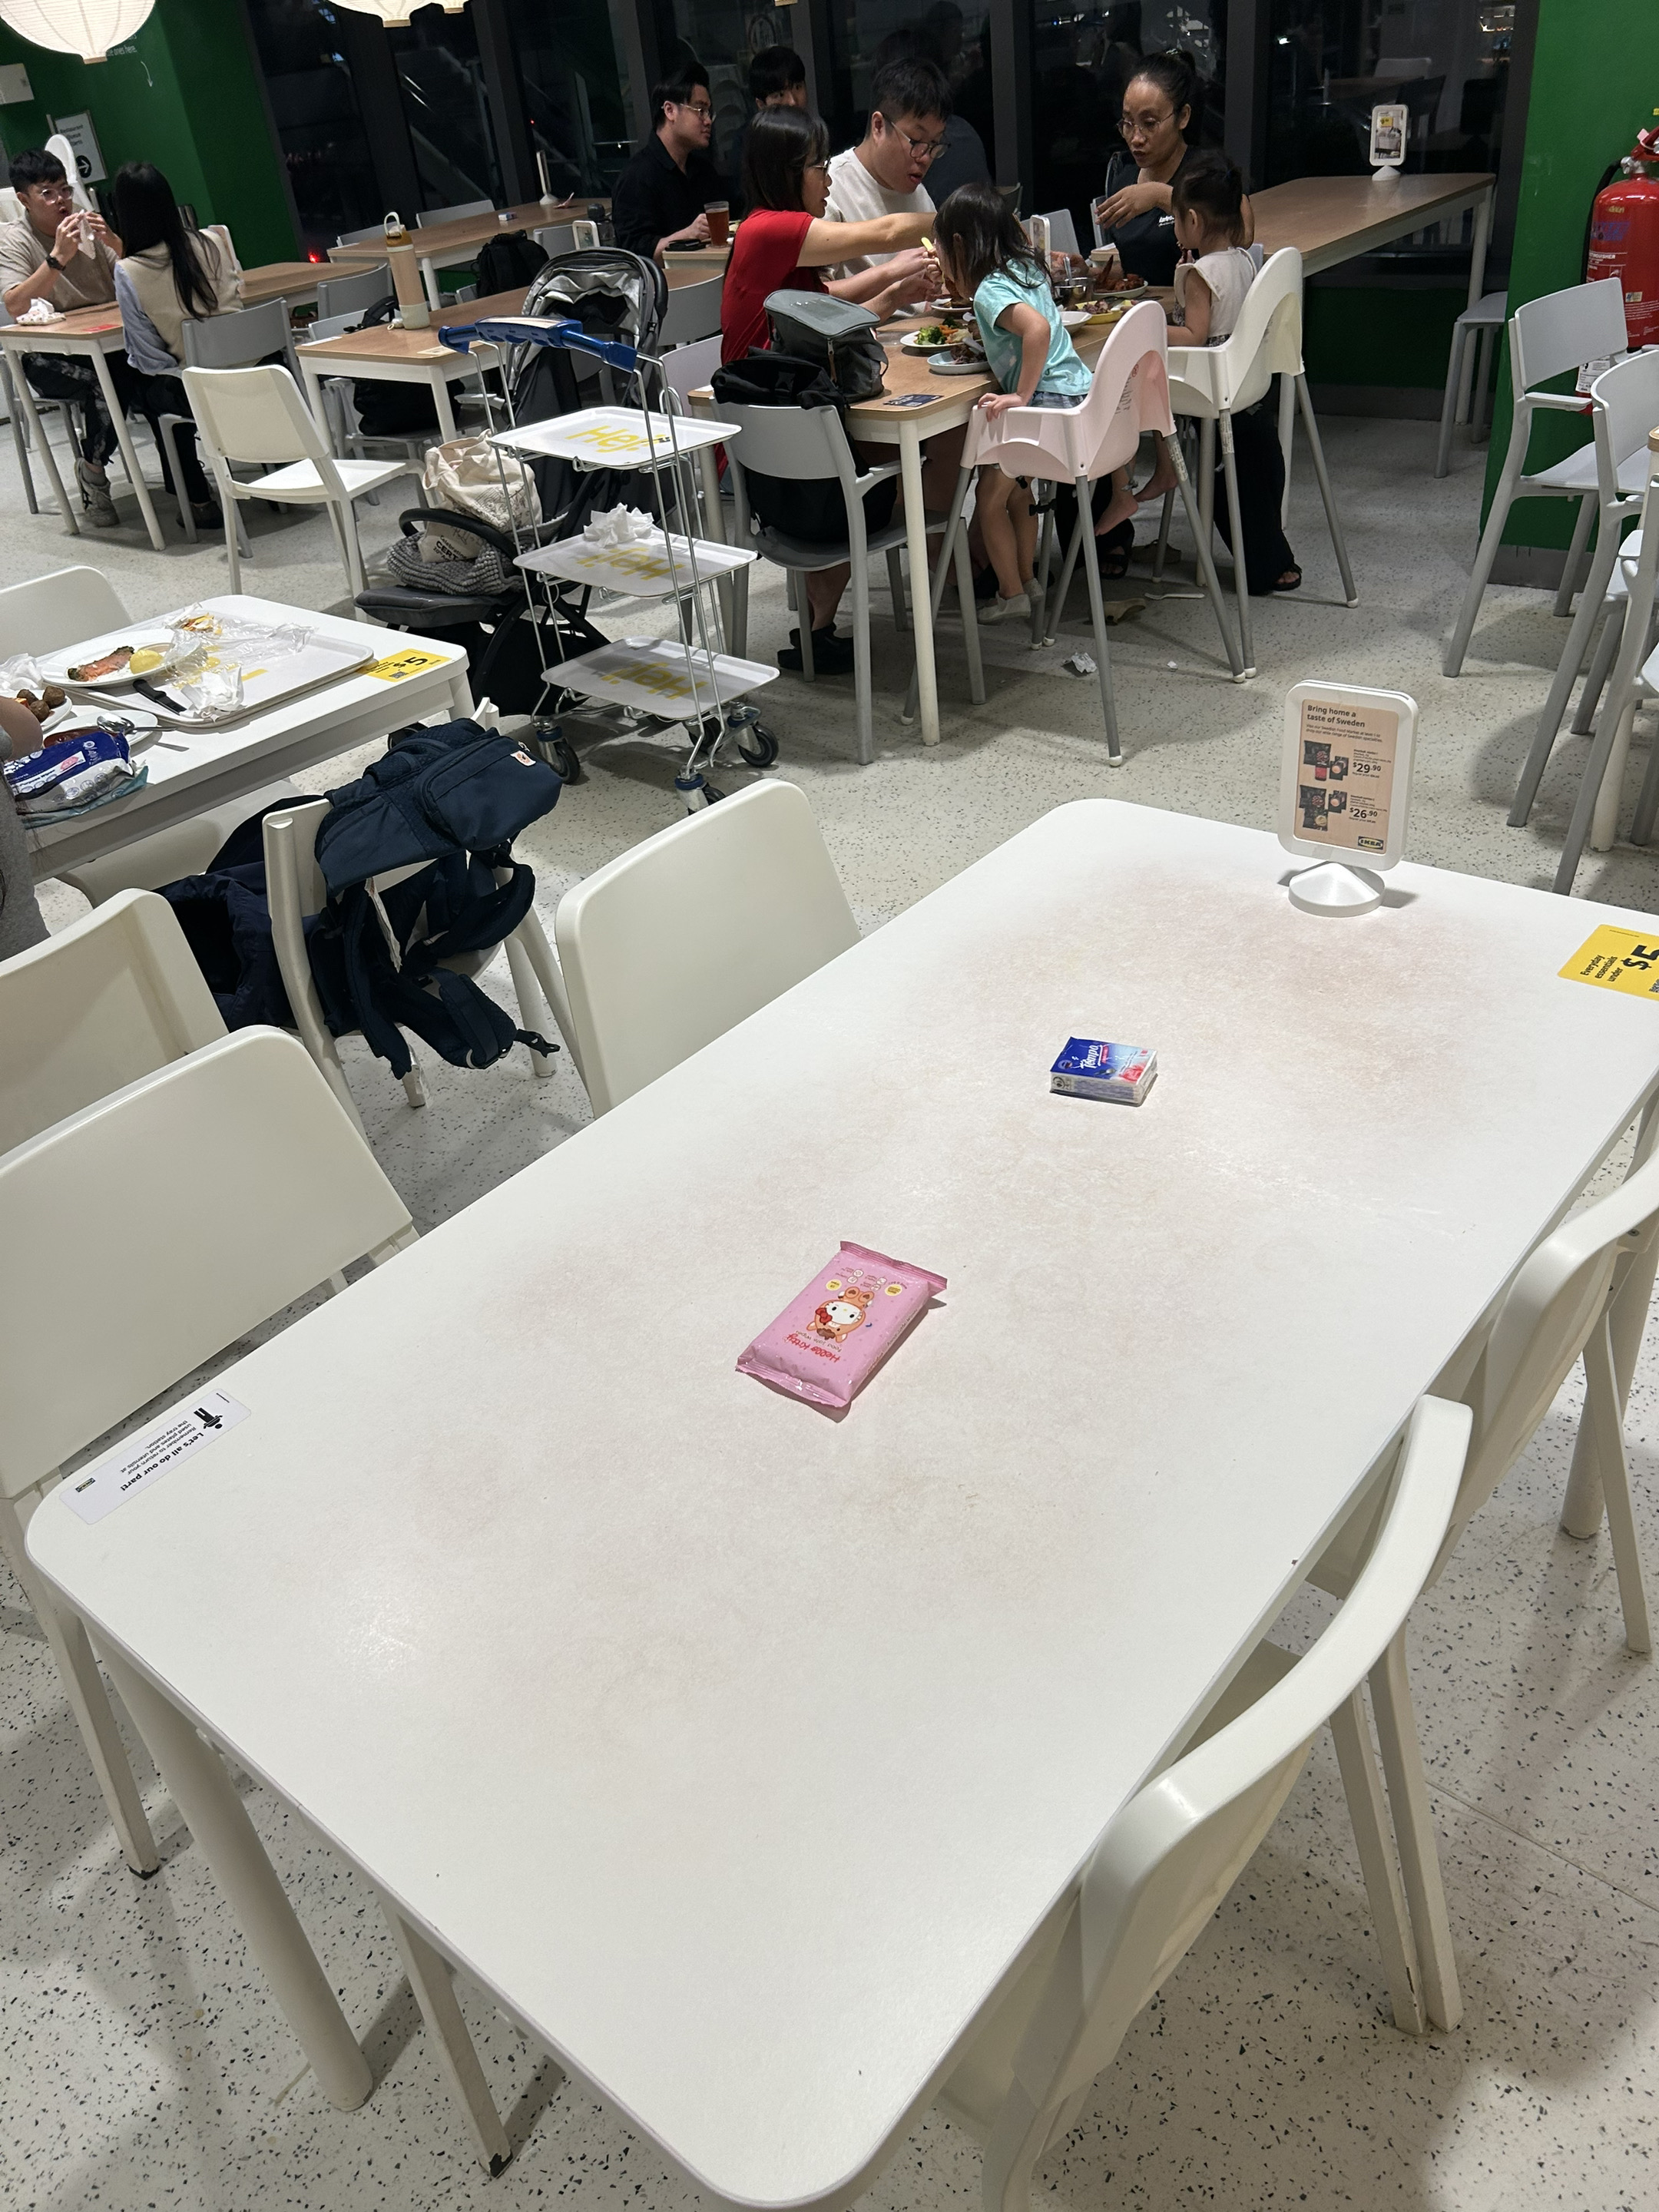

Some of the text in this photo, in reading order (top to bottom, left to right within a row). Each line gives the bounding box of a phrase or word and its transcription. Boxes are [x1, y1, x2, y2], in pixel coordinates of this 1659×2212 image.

[1307, 705, 1327, 715] Bring
[1329, 707, 1349, 717] home
[1307, 714, 1326, 722] taste
[1336, 717, 1365, 727] Sweden
[1353, 762, 1381, 773] $29.90
[1349, 807, 1378, 819] $26.90
[1580, 955, 1605, 976] Everyday
[1594, 956, 1618, 979] essentials
[1607, 968, 1623, 982] under
[1084, 1044, 1099, 1069] Tempo
[786, 1333, 841, 1363] Hello Kitty
[178, 1424, 191, 1434] used
[145, 1435, 166, 1449] station.
[161, 1432, 177, 1445] plates
[167, 1427, 196, 1448] Remember
[150, 1445, 160, 1453] and
[121, 1432, 204, 1491] Let's all do our part!
[127, 1453, 148, 1468] utensils
[141, 1452, 158, 1465] return
[128, 1465, 141, 1474] your
